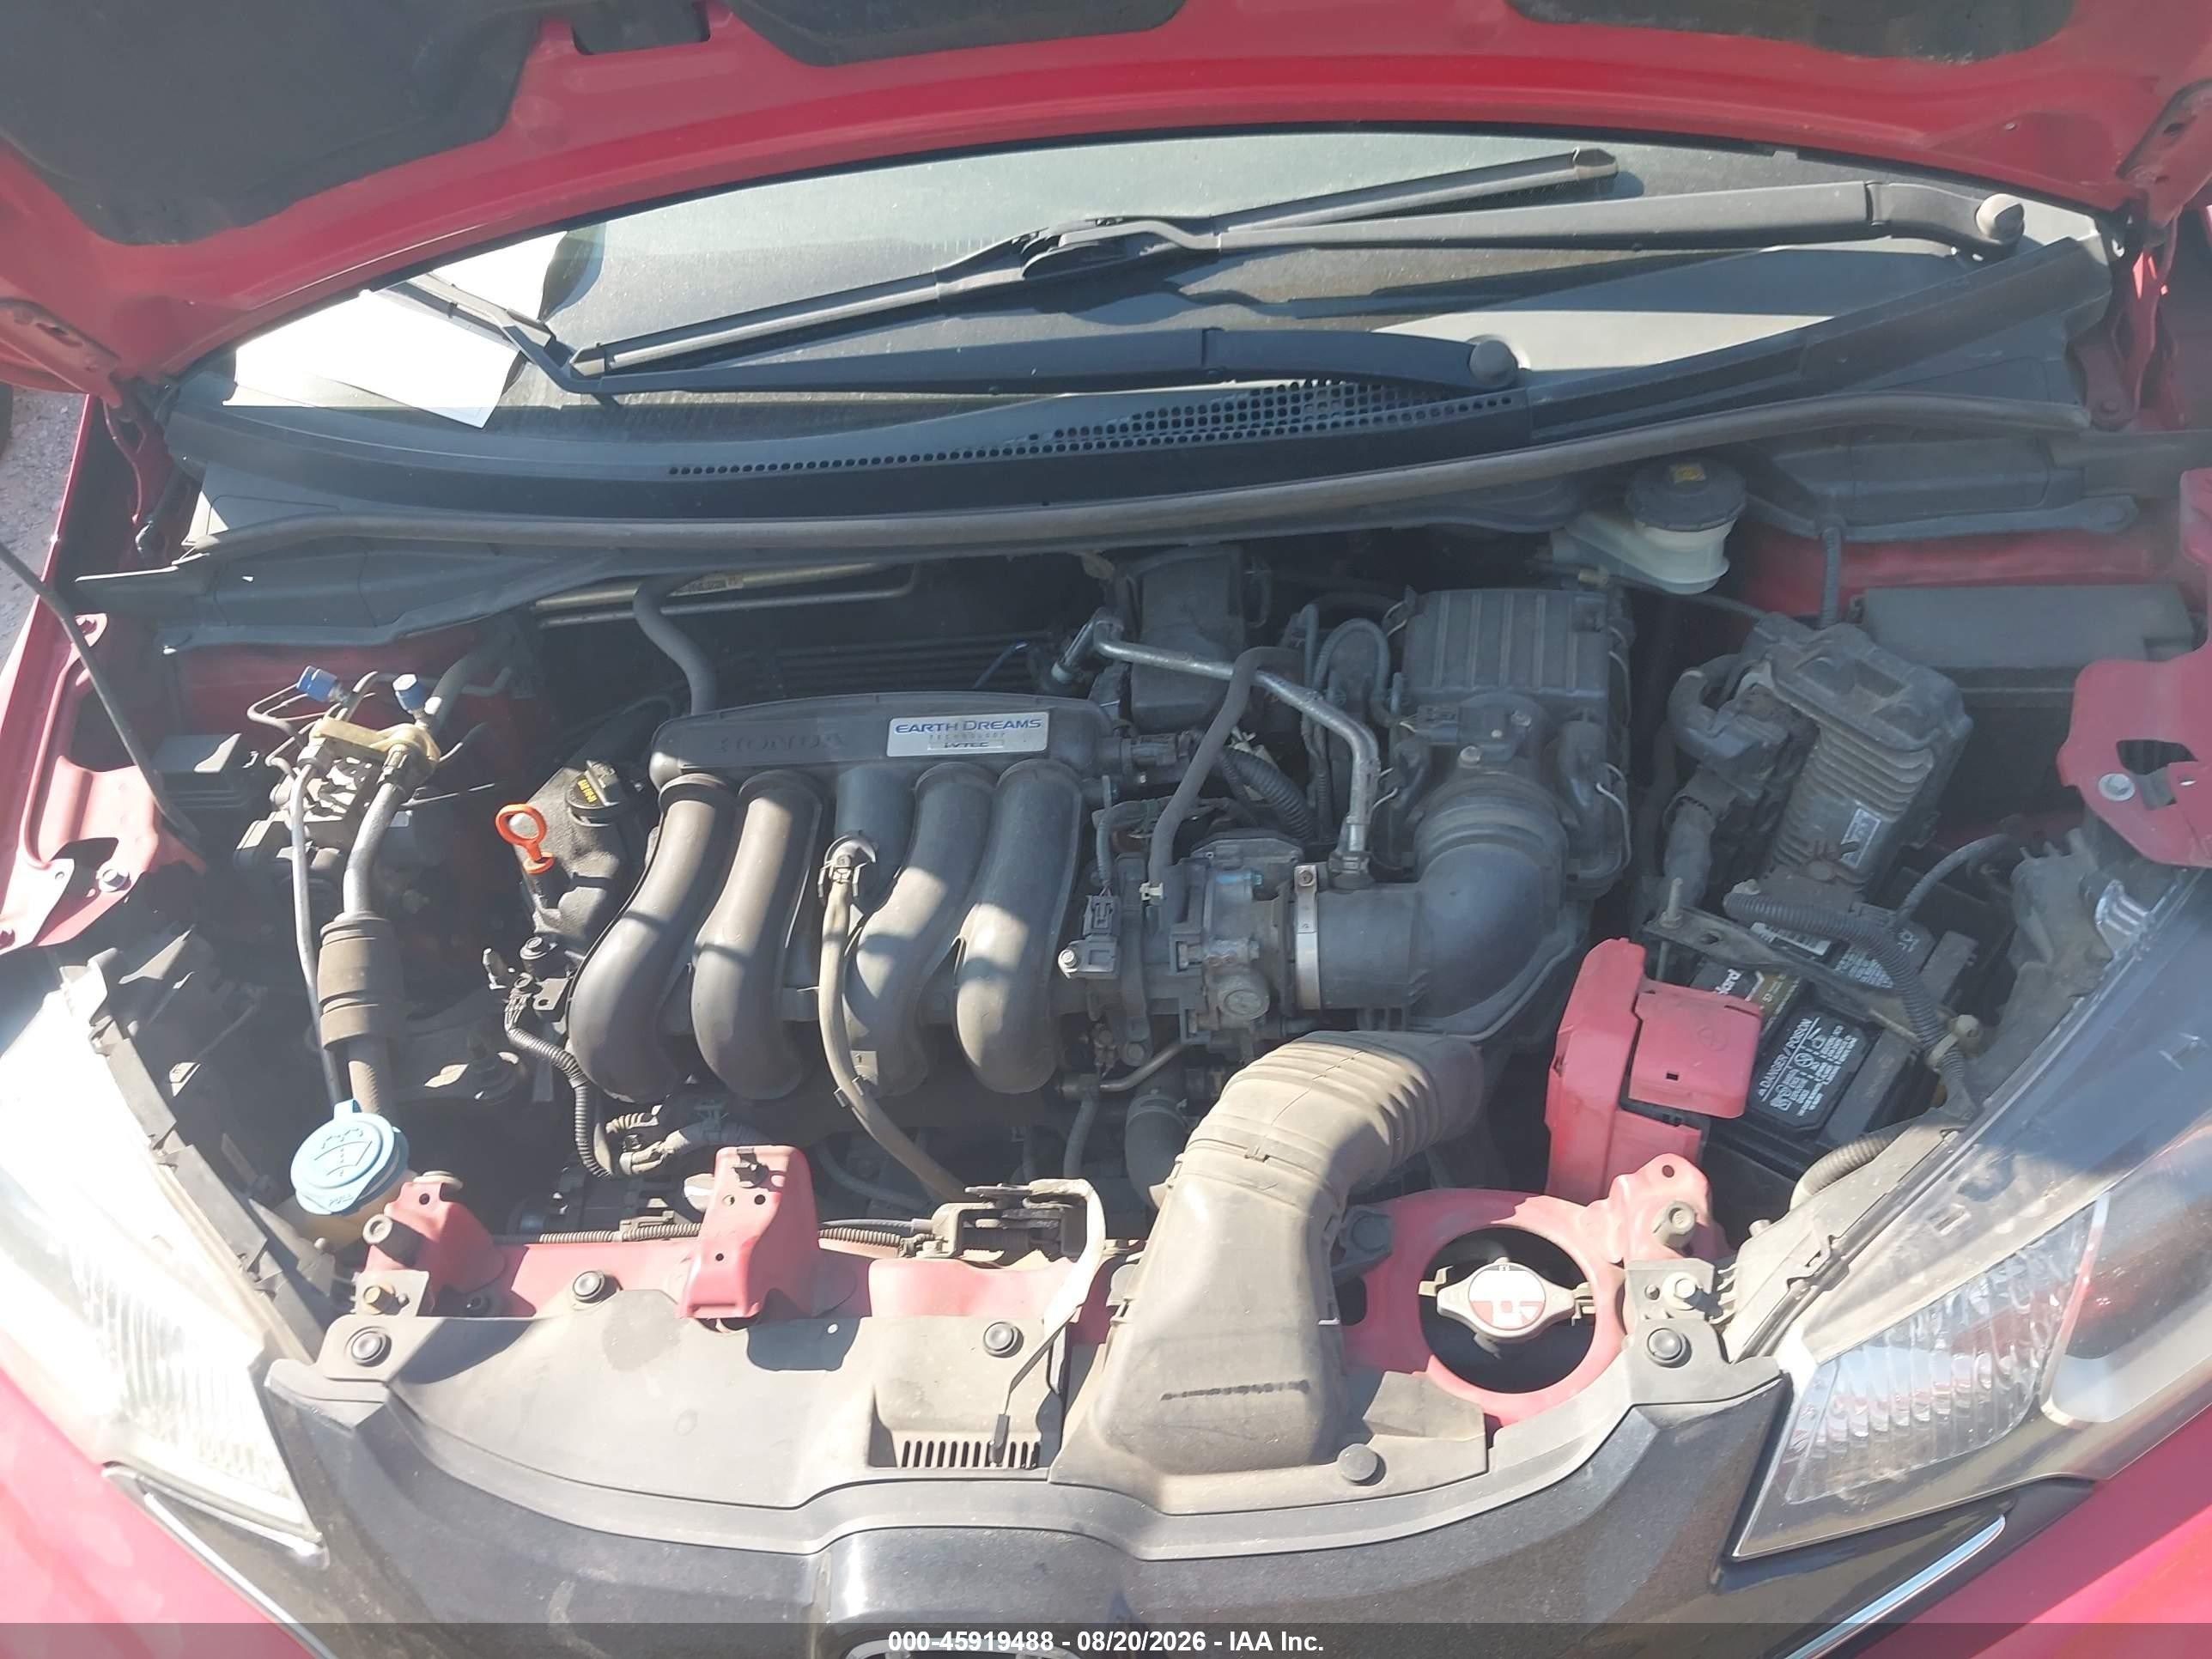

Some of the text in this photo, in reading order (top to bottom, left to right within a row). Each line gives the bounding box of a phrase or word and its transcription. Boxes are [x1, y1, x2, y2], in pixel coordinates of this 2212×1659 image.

[895, 719, 1042, 734] EARTH DREAMS
[1759, 1053, 1790, 1089] DANGER
[1785, 1018, 1813, 1049] POISON
